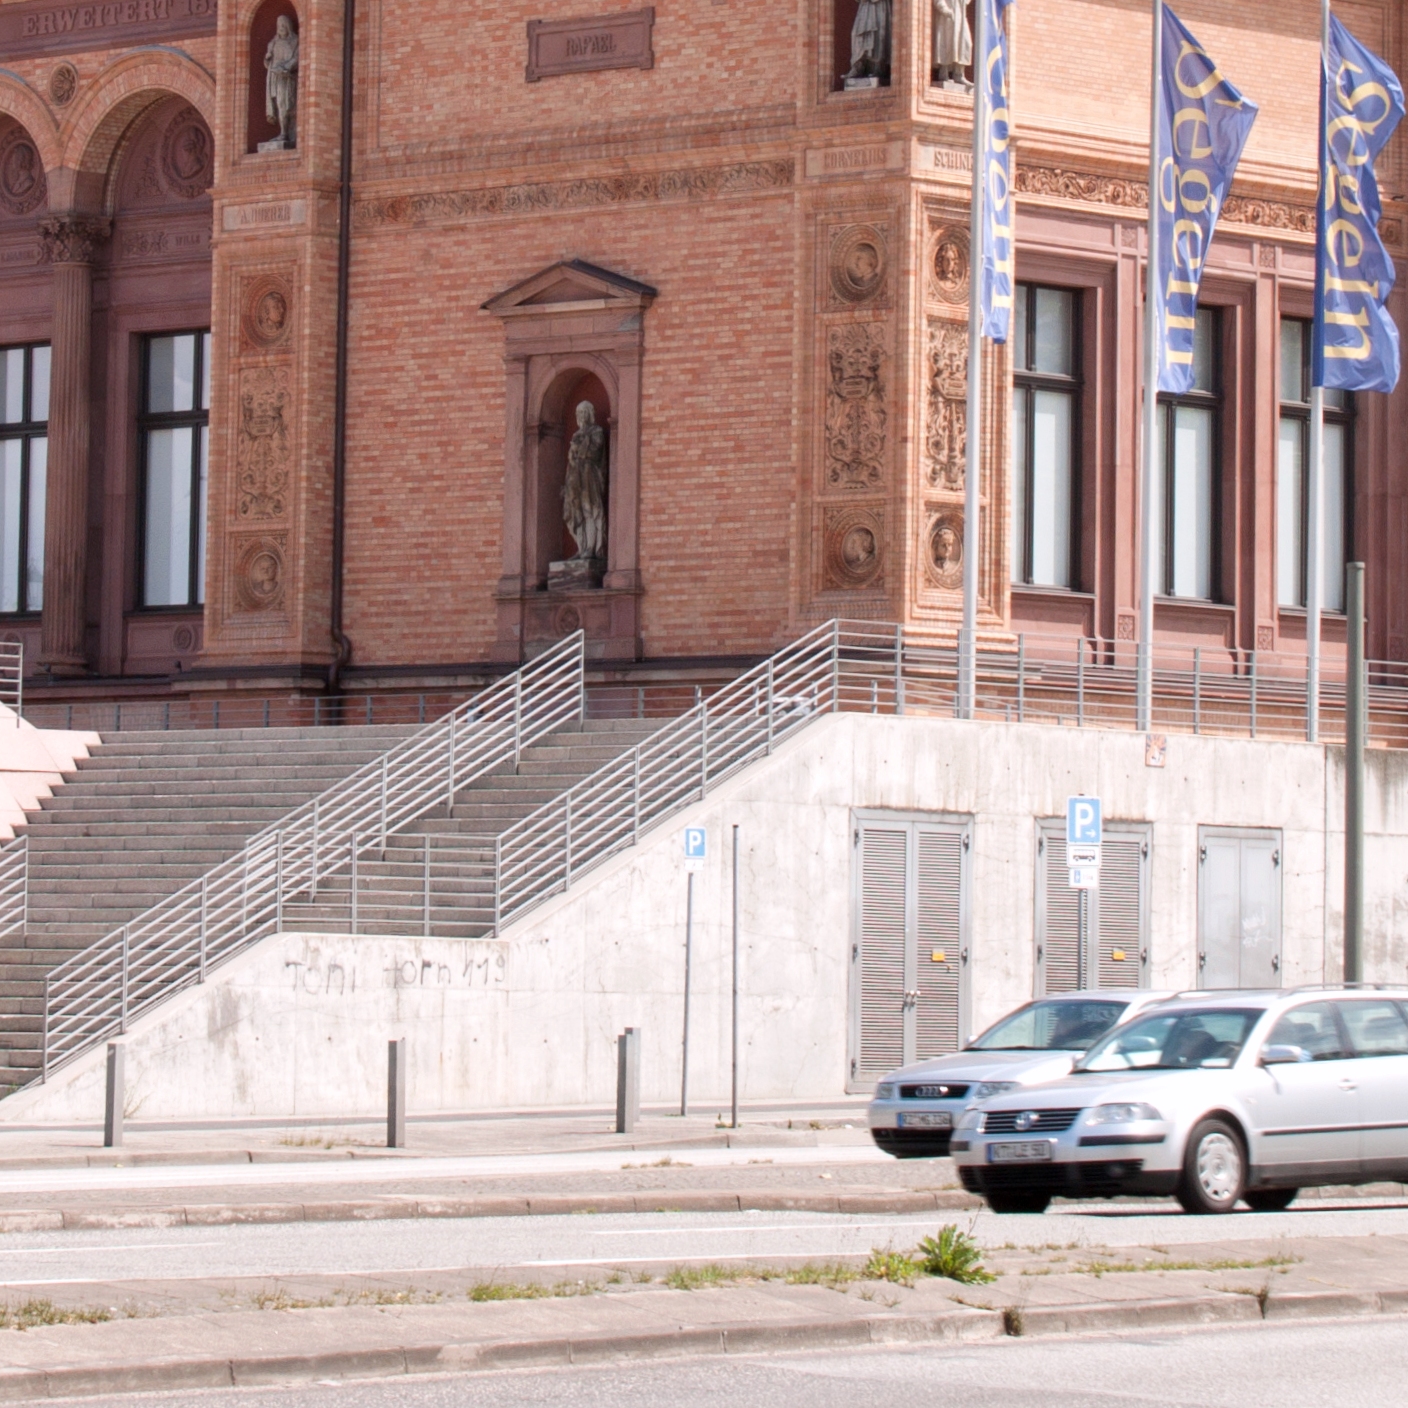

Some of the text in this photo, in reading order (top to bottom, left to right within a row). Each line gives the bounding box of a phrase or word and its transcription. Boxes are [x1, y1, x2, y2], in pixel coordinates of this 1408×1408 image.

[934, 149, 974, 173] SCHIN
[1322, 57, 1392, 360] Segeln
[1075, 802, 1094, 839] P
[689, 831, 702, 855] P
